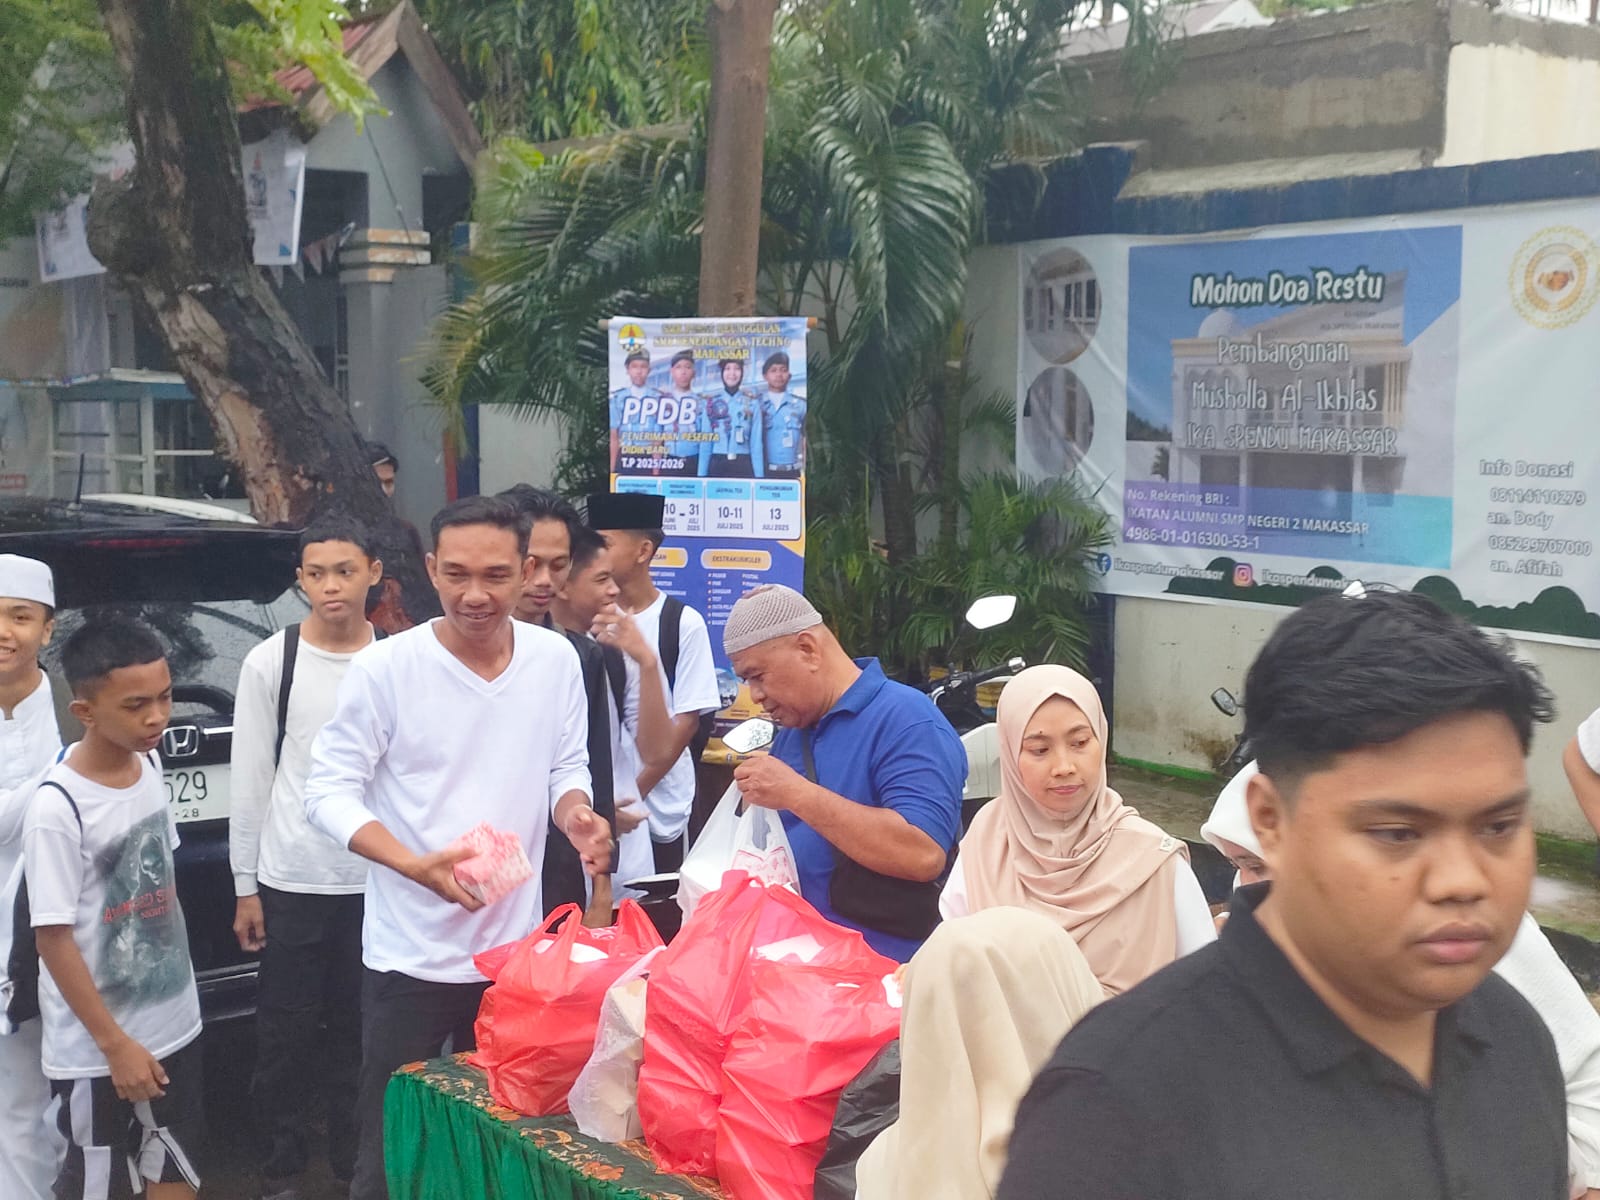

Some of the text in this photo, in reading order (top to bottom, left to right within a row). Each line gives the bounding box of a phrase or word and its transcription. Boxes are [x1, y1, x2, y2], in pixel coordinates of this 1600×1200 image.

[1192, 265, 1384, 306] Mohon Doa Restu
[693, 348, 750, 360] MAKASSAR
[1217, 334, 1350, 372] Pembangunan
[1192, 379, 1267, 411] Musholla
[621, 398, 697, 425] PPDB
[621, 431, 720, 442] PENERIMAAN PESERTA
[1187, 422, 1398, 453] IKA SPENDU MAKASSAR
[621, 457, 685, 469] T.P 2025/2026
[1480, 459, 1574, 478] Info Donasi
[1127, 489, 1148, 501] No.
[1150, 490, 1203, 506] Rekening
[1205, 492, 1223, 505] BRI
[664, 503, 676, 514] 10
[689, 503, 700, 515] 31
[718, 506, 743, 519] 10-11
[770, 508, 782, 520] 13
[1127, 507, 1369, 534] IKATAN ALUMNI SMP NEGERI 2 MAKASSAR
[1487, 510, 1554, 530] an. Dody
[1126, 526, 1260, 549] 4986-01-016300-53-1
[1114, 557, 1225, 580] ikaspendumakassar
[1490, 560, 1512, 573] an.
